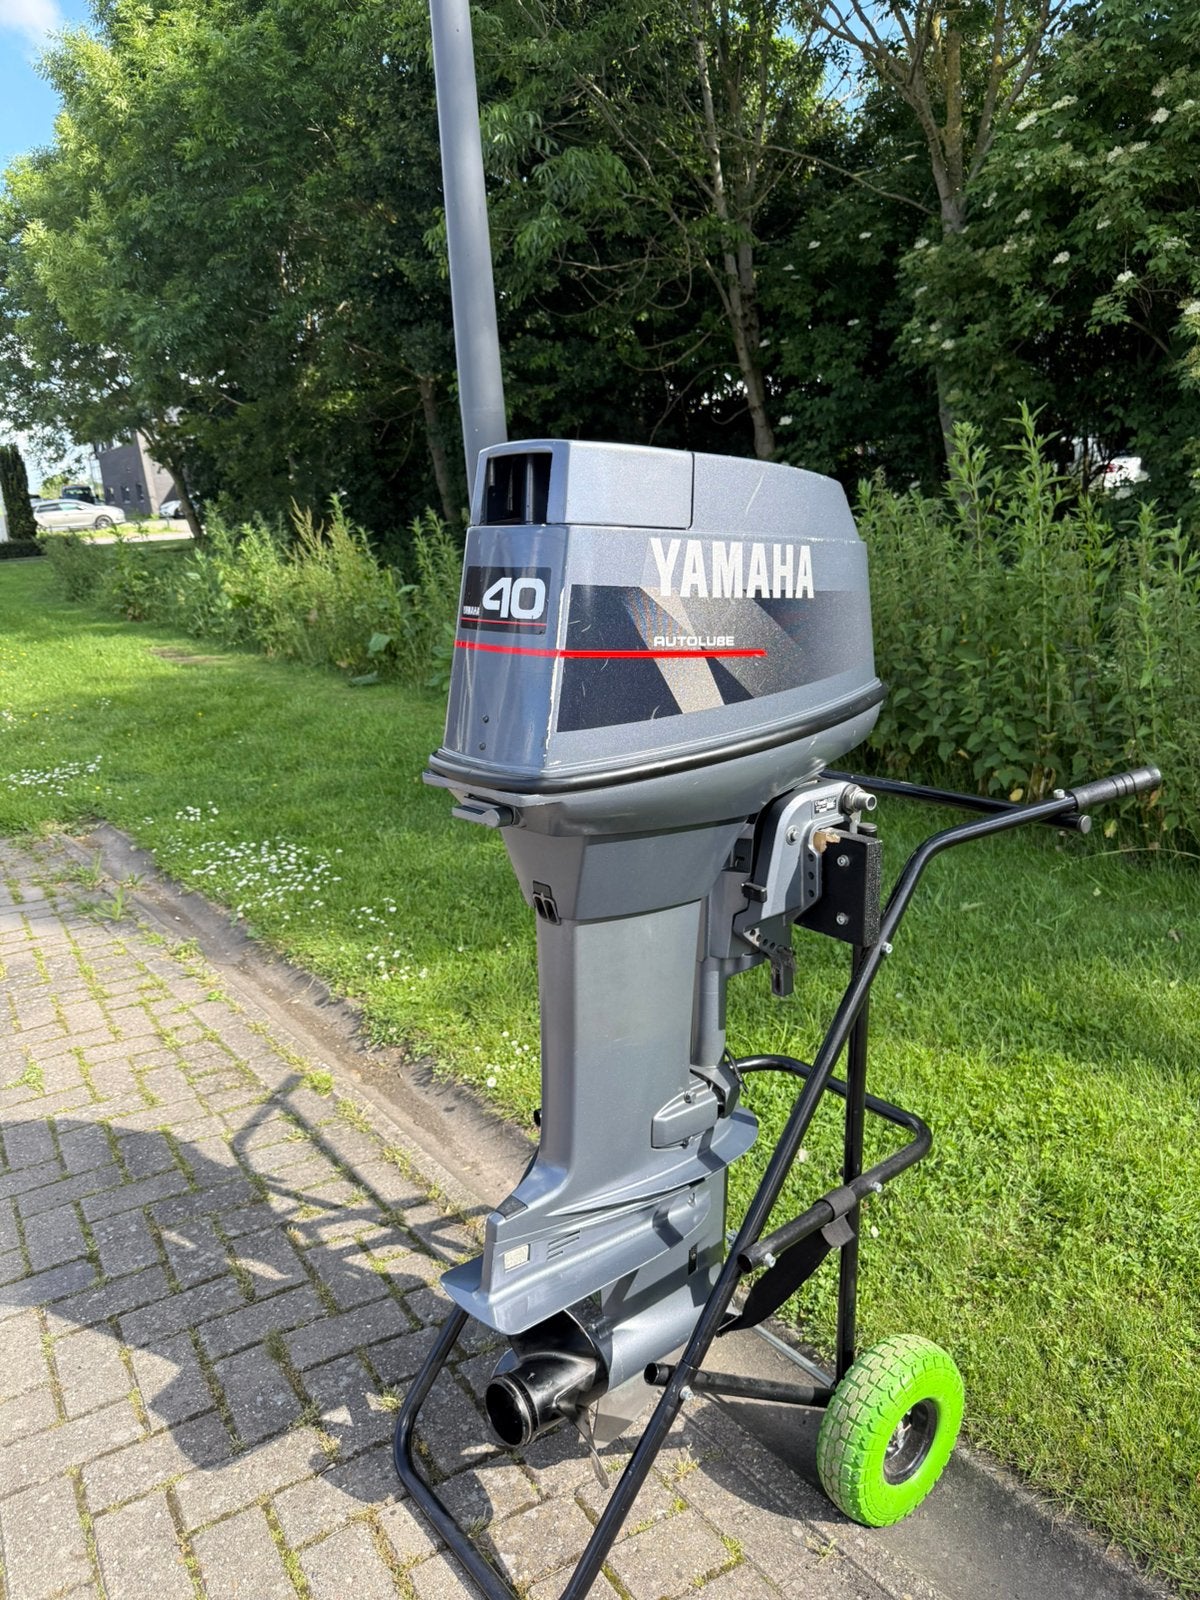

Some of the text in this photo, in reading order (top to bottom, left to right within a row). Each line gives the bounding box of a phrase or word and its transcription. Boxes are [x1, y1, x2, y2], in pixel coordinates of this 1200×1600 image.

[650, 537, 814, 599] YAMAHA
[482, 577, 546, 620] 40
[653, 635, 735, 647] AUTOLUBE
